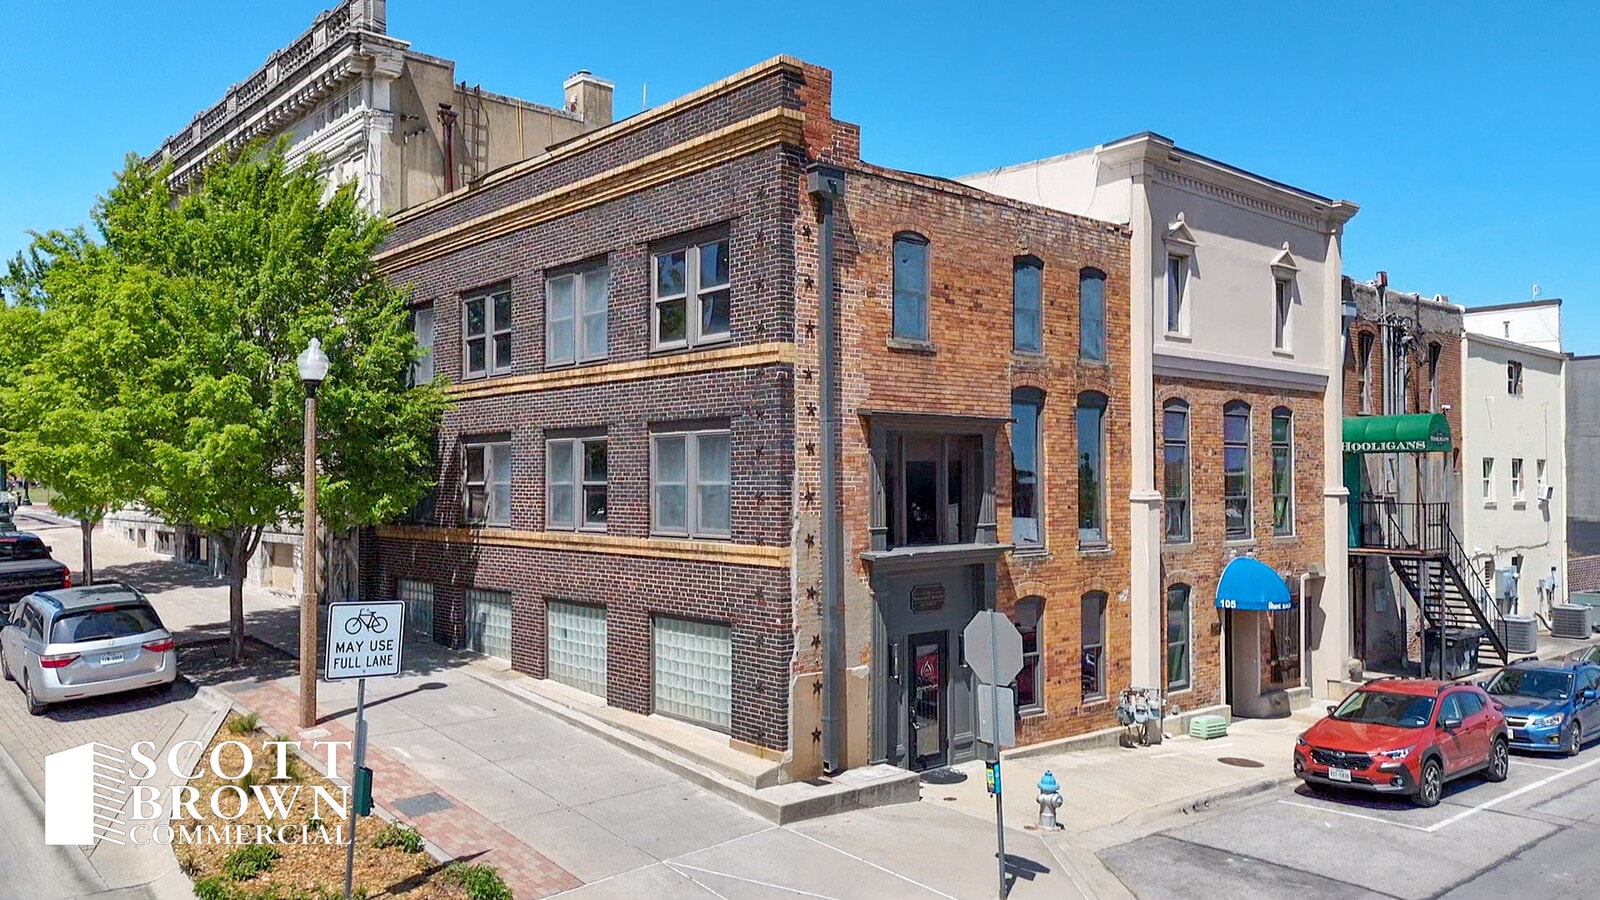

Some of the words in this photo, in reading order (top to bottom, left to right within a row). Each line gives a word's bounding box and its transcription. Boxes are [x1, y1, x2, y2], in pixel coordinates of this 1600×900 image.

[1341, 441, 1425, 451] HOOLIGANS
[1220, 599, 1236, 608] 105
[335, 641, 364, 654] MAY
[369, 639, 394, 652] USE
[333, 656, 361, 670] FULL
[366, 654, 393, 668] LANE
